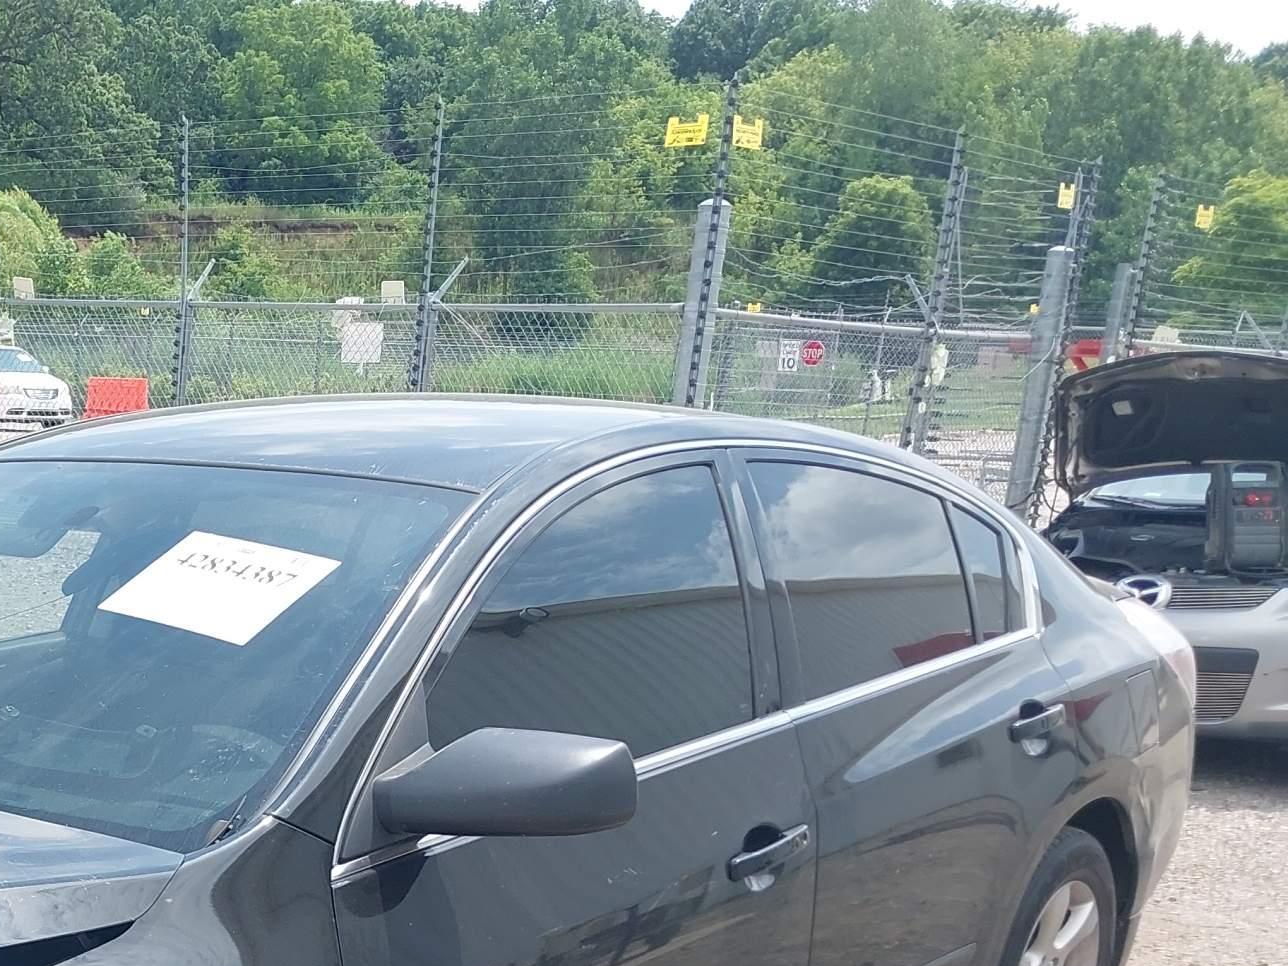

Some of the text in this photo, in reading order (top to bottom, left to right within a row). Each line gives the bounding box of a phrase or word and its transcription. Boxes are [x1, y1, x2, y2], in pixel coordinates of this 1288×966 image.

[802, 348, 823, 359] STOP
[781, 357, 796, 369] 10
[176, 552, 298, 587] 42834387
